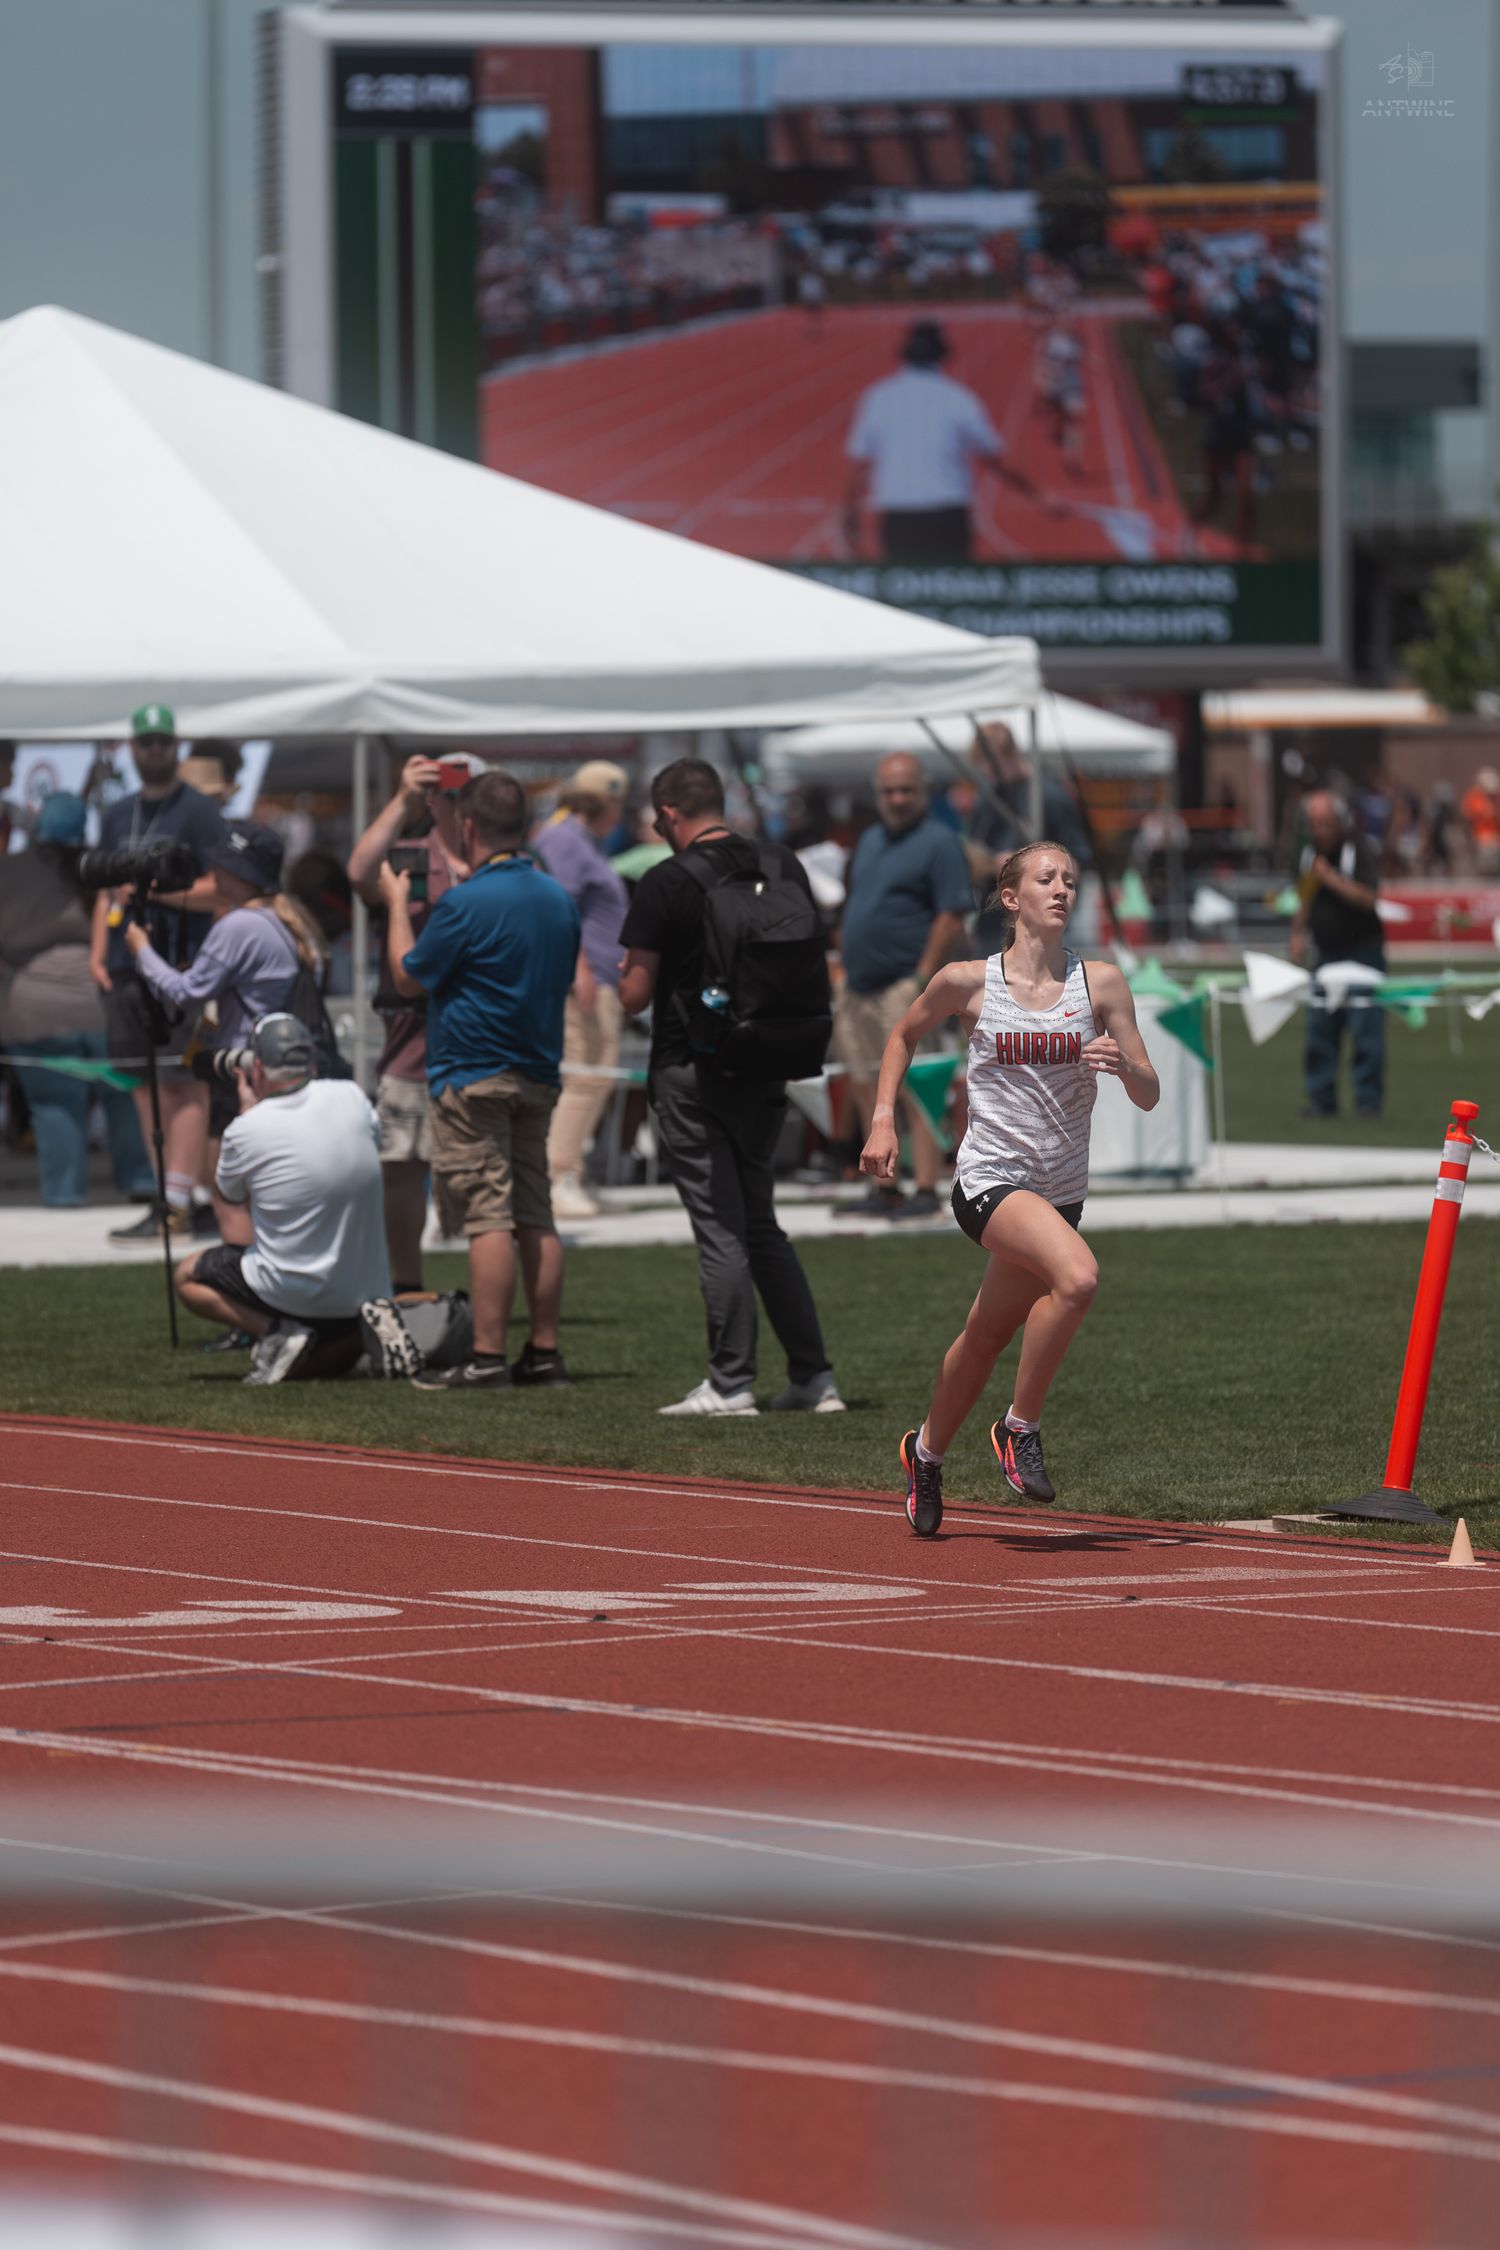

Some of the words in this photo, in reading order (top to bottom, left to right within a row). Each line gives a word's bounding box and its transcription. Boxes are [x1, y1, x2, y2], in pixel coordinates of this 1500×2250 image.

[1010, 566, 1099, 603] JESSE
[1104, 566, 1237, 602] OWENS
[996, 1031, 1083, 1066] HURON
[427, 1581, 927, 1610] 2
